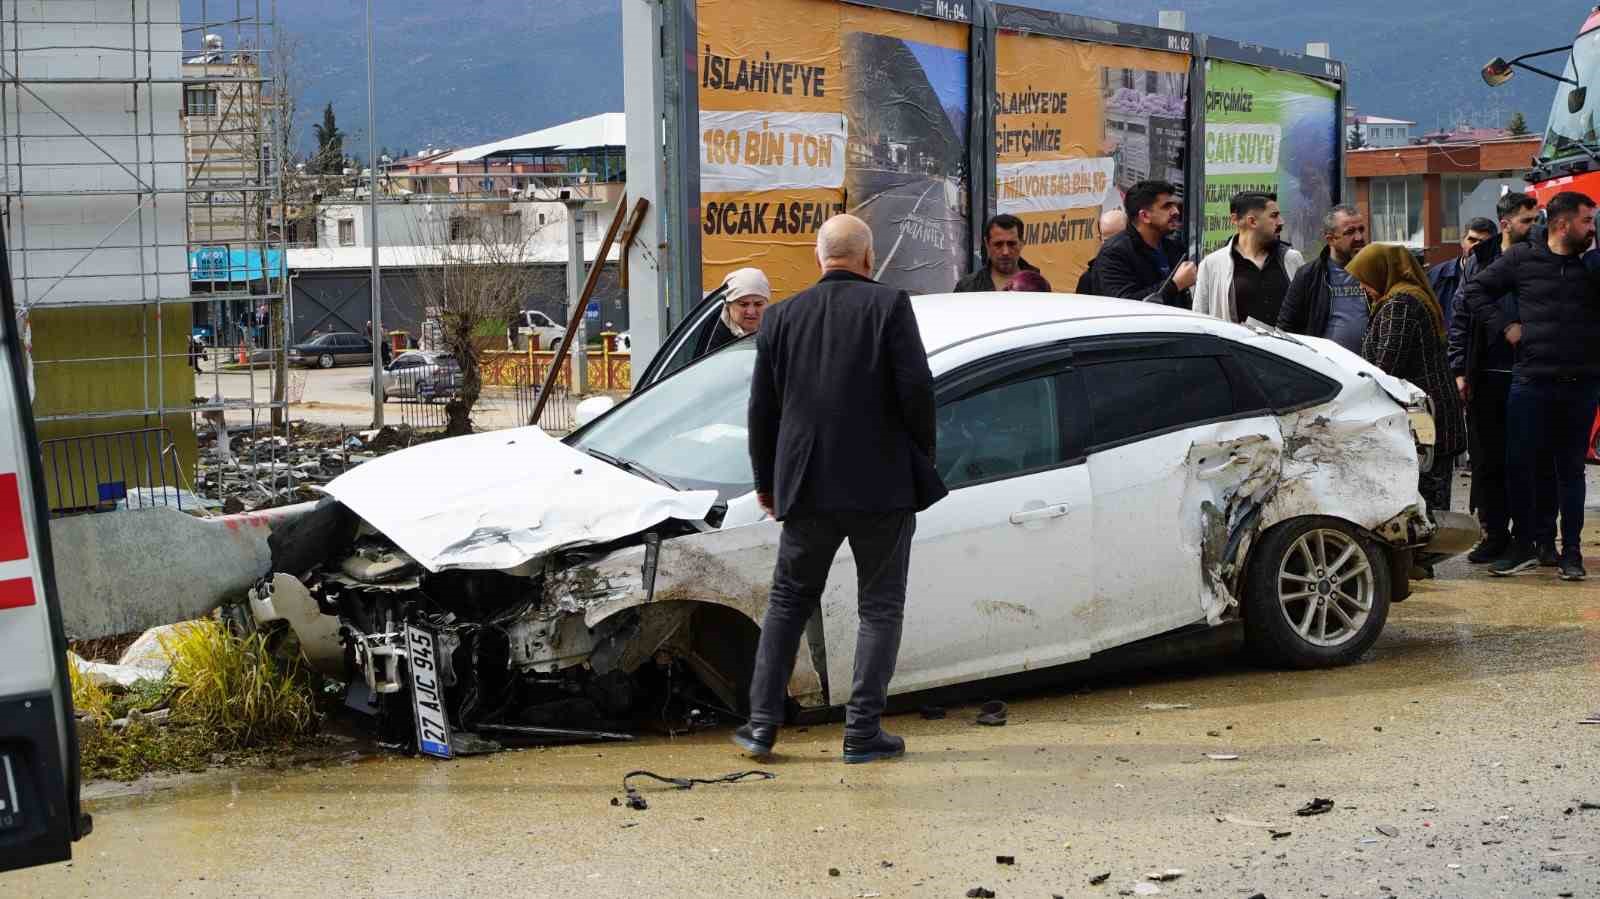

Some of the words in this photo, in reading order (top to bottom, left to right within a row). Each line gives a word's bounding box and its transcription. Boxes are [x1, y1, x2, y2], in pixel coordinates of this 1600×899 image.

[703, 44, 825, 97] İSLAHİYE'YE
[994, 85, 1067, 114] SLAHİYE'DE
[703, 128, 740, 165] 180
[744, 120, 785, 166] BİN
[790, 133, 832, 168] TON
[1205, 131, 1234, 163] CAN
[1239, 132, 1275, 164] SUYU
[703, 201, 769, 235] SICAK
[771, 201, 844, 235] ASFA
[411, 632, 433, 671] 945
[415, 675, 441, 713] AJC
[421, 716, 446, 744] 27
